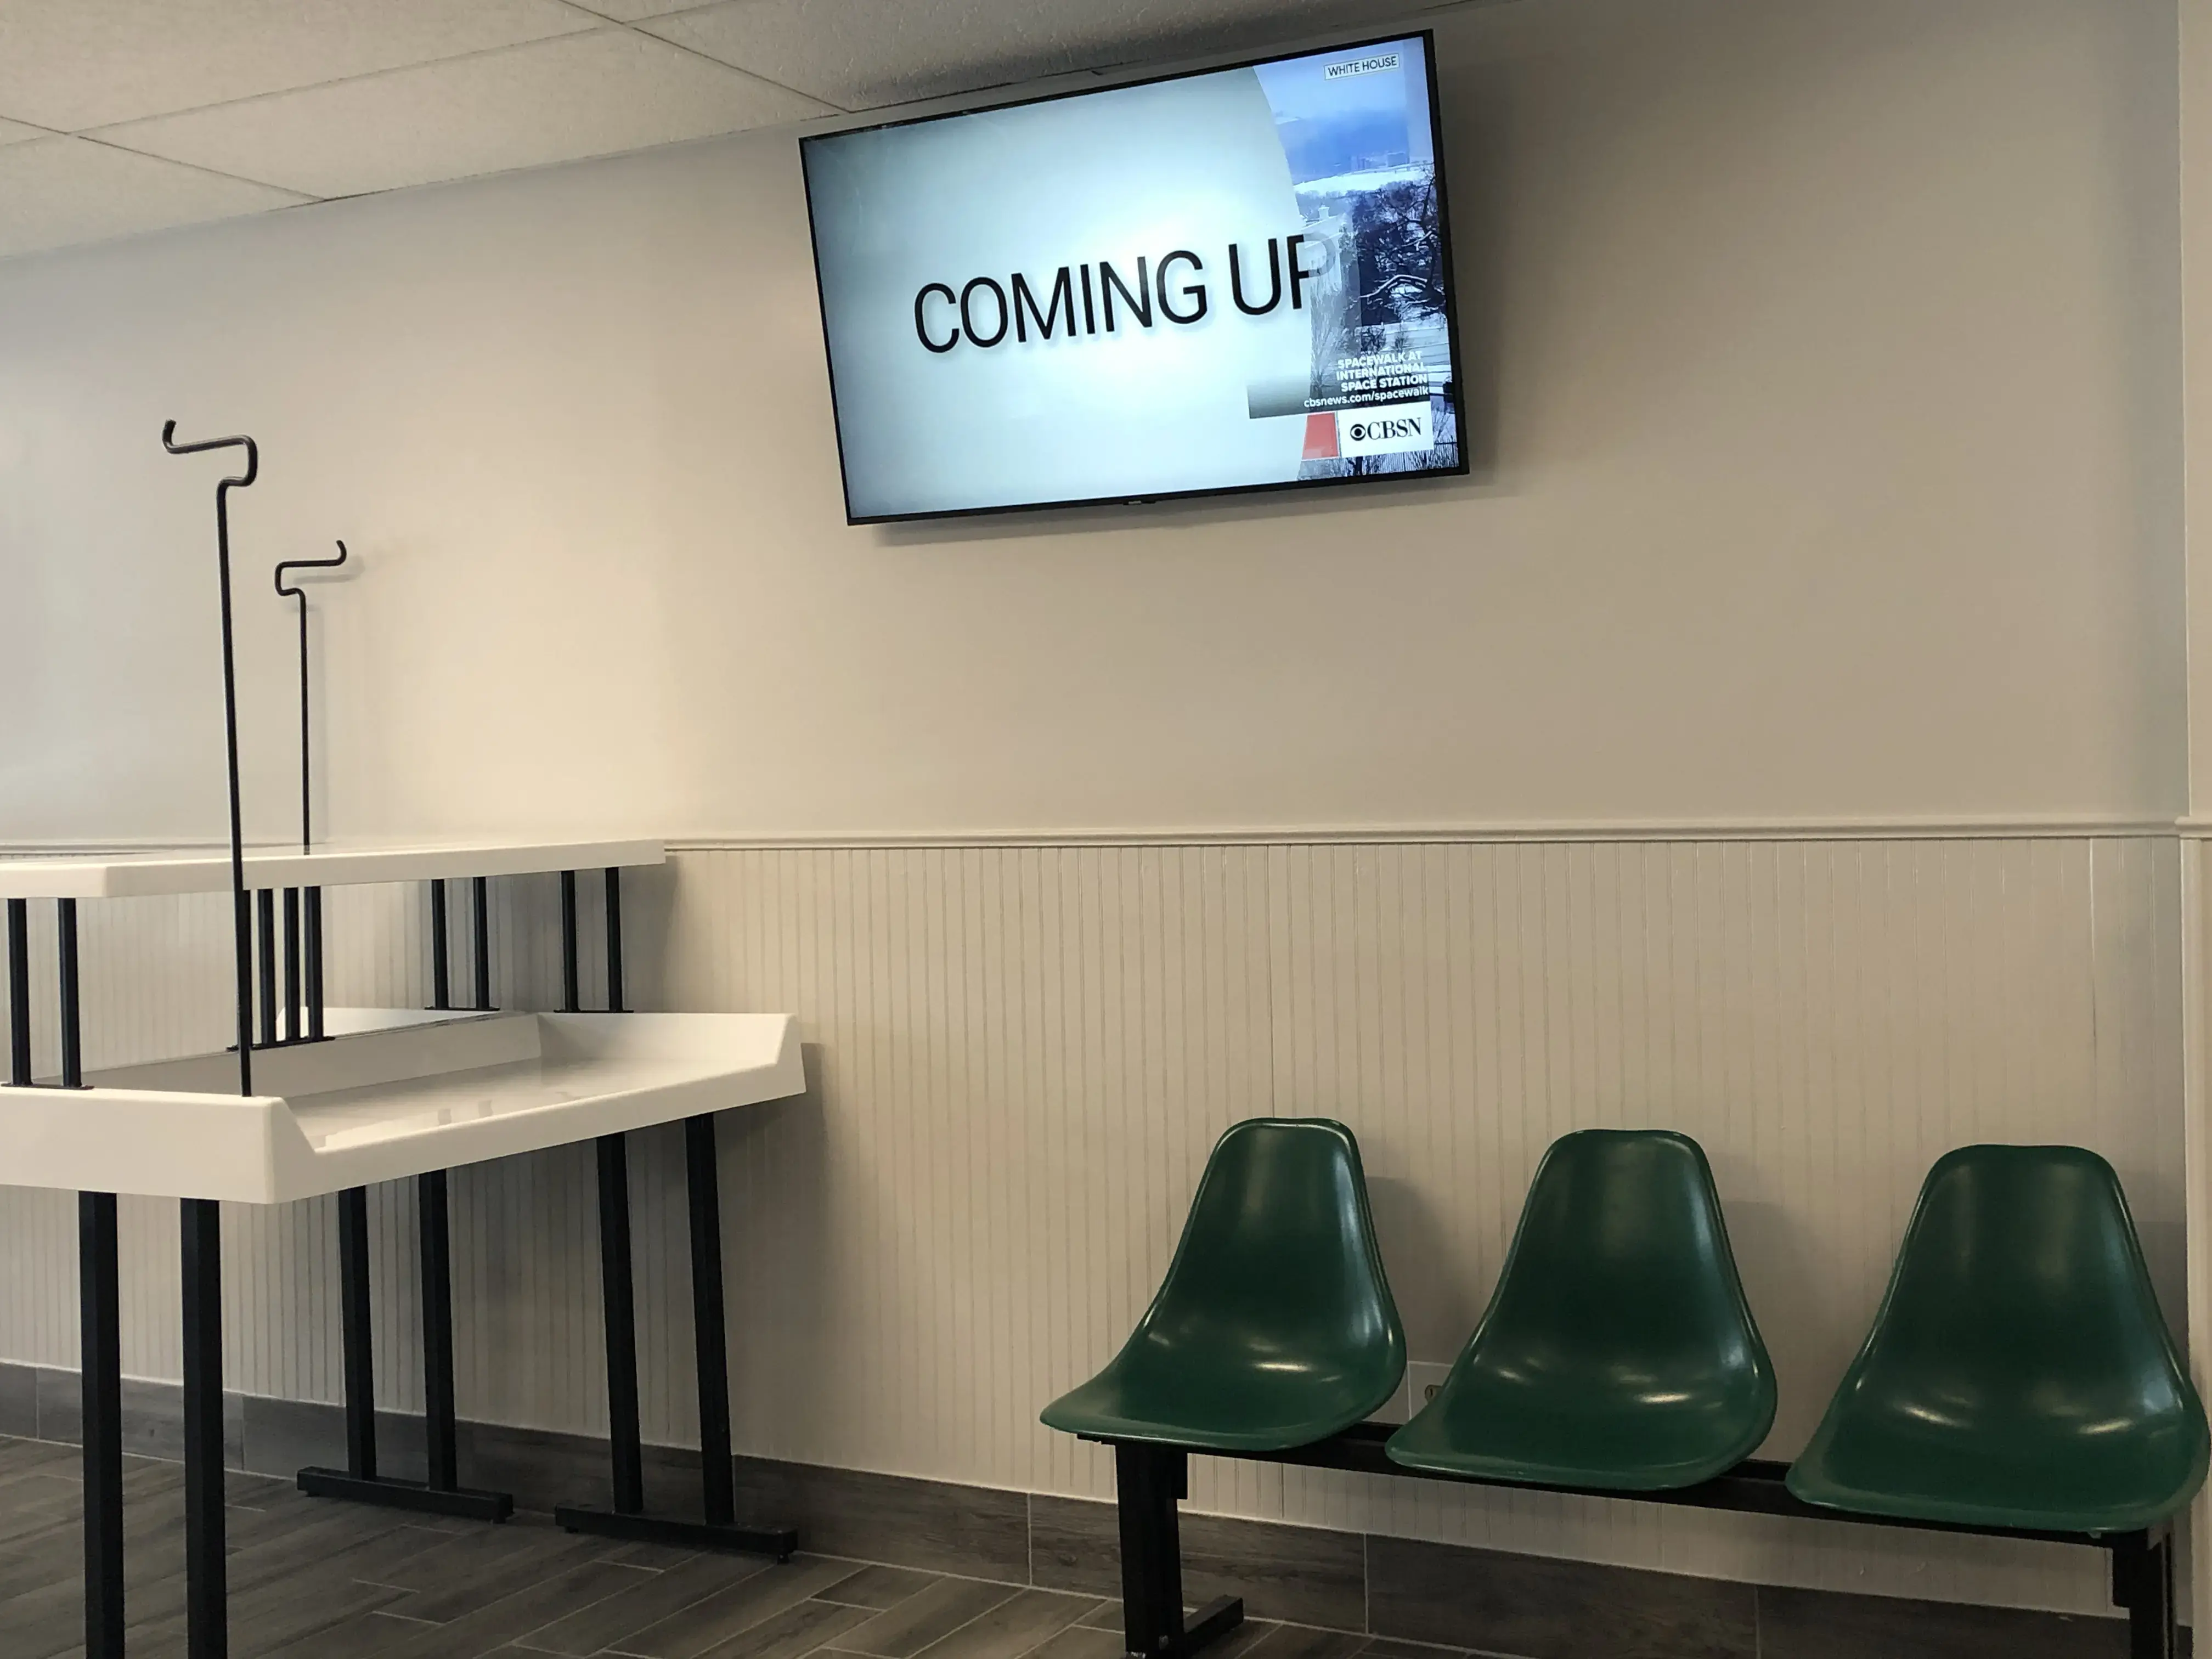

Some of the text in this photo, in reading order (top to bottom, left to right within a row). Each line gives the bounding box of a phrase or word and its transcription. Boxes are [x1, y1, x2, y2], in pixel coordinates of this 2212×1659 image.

[1328, 56, 1397, 76] WHITE HOUSE
[915, 233, 1336, 354] COMING UP
[1338, 351, 1423, 369] SPACEWALK AT
[1336, 362, 1426, 381] INTERNATIONAL
[1341, 374, 1427, 392] SPACE STATION
[1304, 386, 1429, 408] cbsnews.com/spacewalk
[1367, 417, 1422, 441] CBSN
